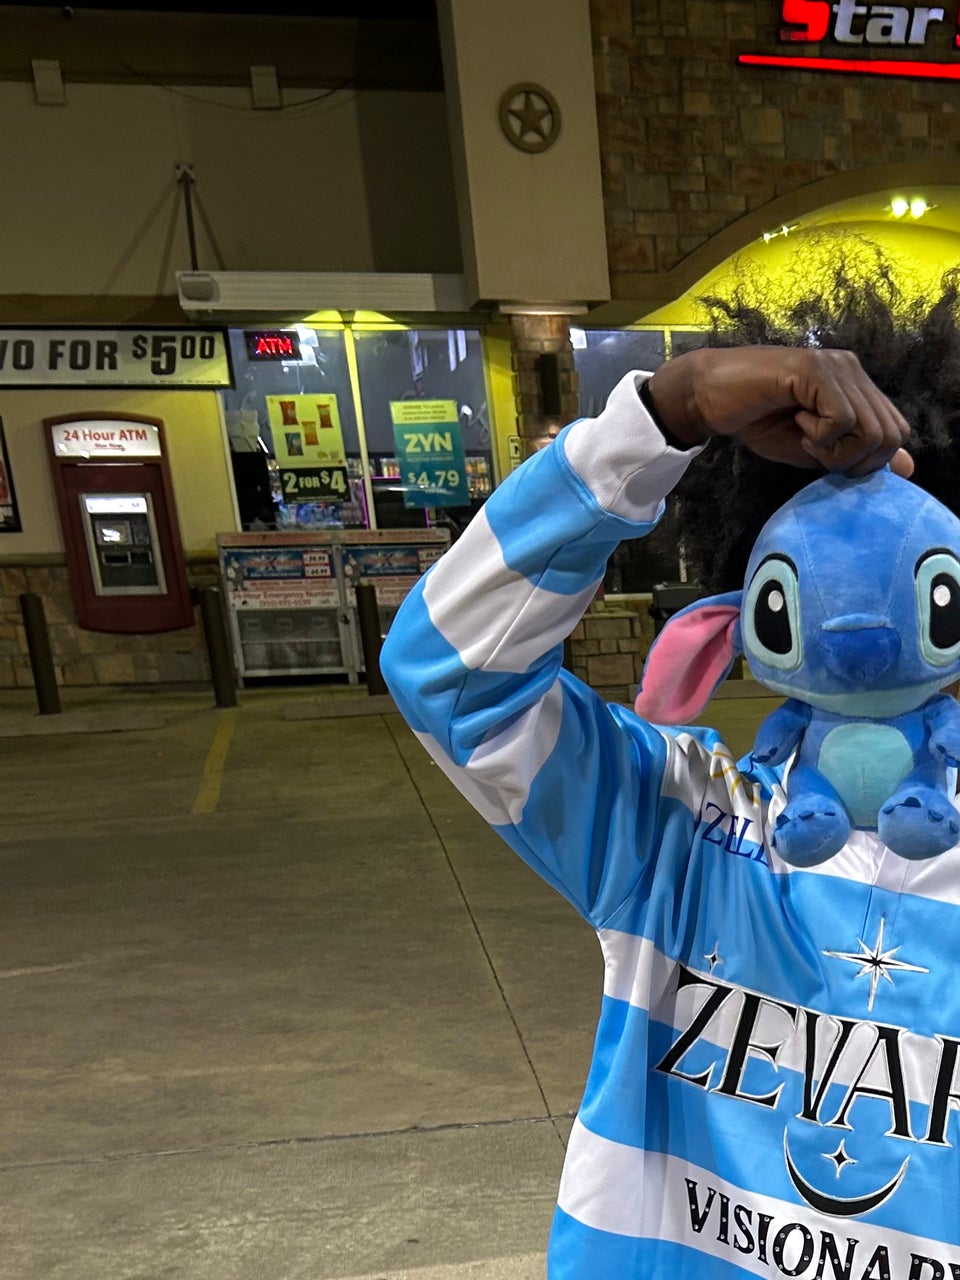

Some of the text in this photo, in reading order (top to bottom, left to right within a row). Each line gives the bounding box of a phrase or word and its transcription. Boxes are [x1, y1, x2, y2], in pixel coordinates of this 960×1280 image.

[779, 0, 944, 44] Star
[48, 340, 118, 371] FOR
[257, 338, 293, 355] ATM
[63, 429, 147, 441] 24 Hour ATM
[404, 432, 453, 453] ZYN
[283, 472, 299, 493] 2
[299, 477, 320, 488] FOR
[408, 470, 459, 487] $4.79
